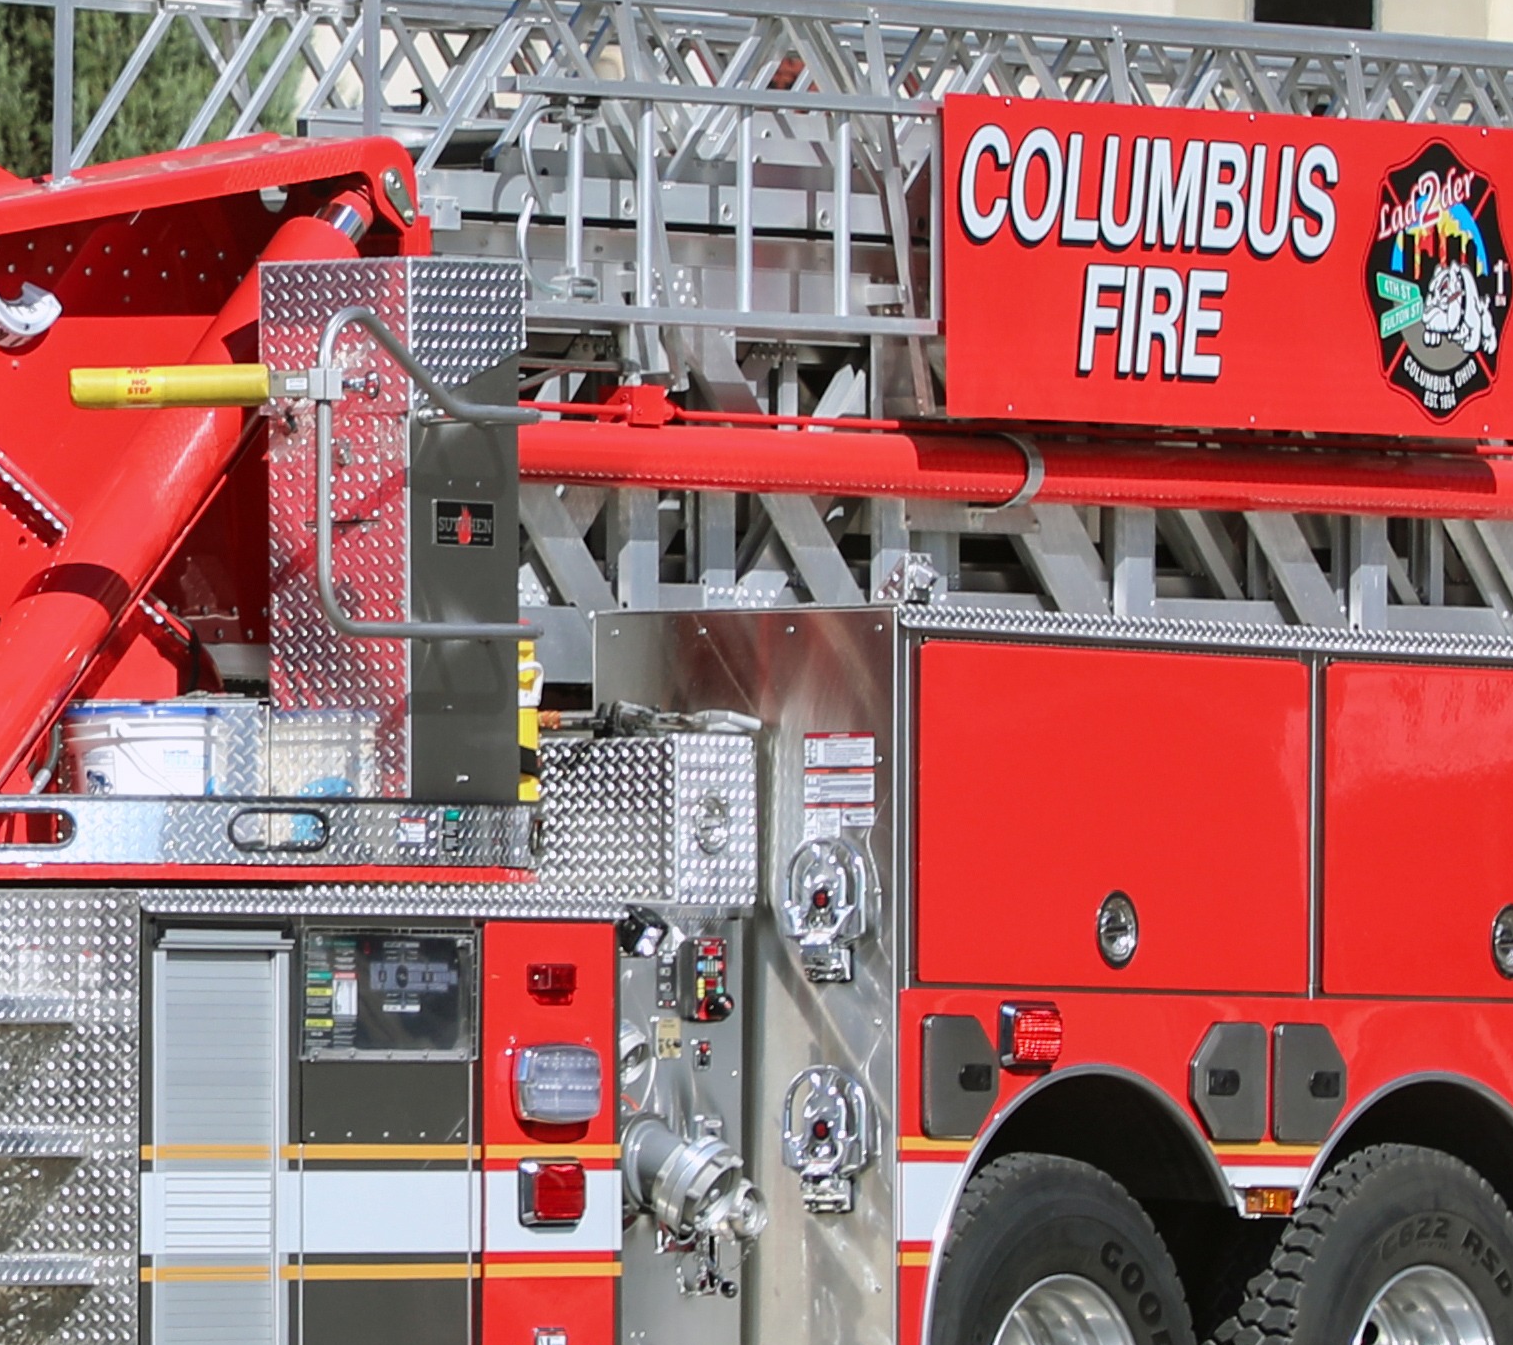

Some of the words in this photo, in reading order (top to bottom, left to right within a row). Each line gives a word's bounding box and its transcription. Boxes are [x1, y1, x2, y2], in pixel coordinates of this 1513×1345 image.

[959, 123, 1340, 263] COLUMBUS
[1076, 263, 1229, 382] FIRE
[126, 386, 153, 395] STEP
[1454, 358, 1477, 389] OHIO
